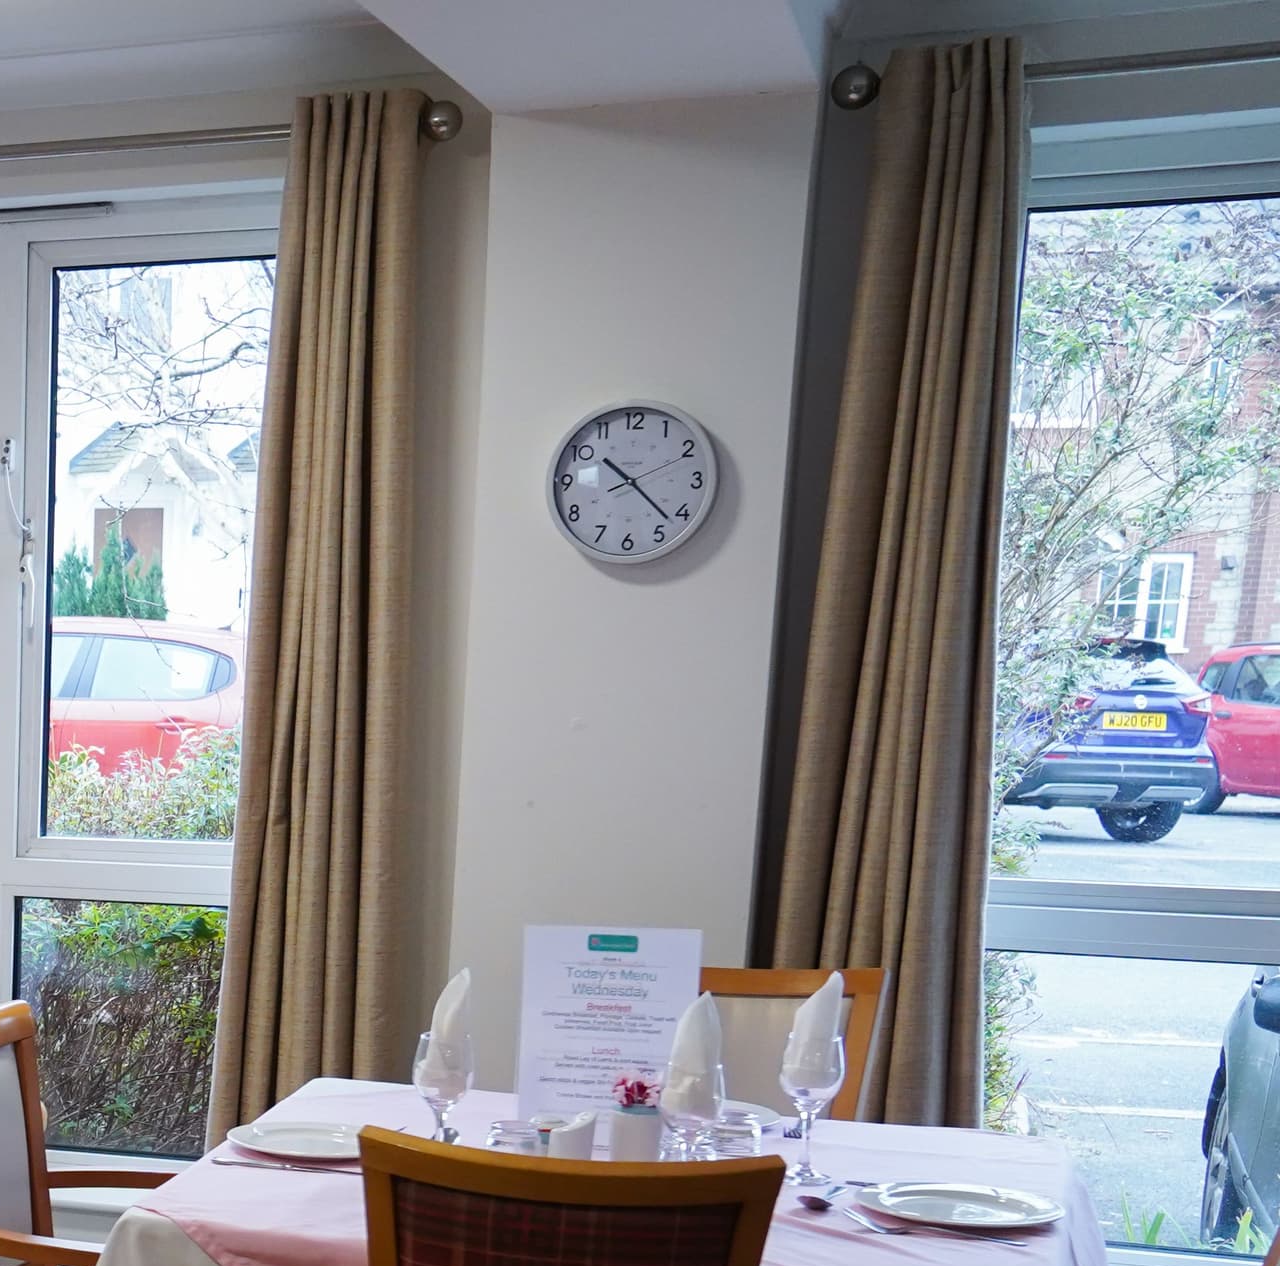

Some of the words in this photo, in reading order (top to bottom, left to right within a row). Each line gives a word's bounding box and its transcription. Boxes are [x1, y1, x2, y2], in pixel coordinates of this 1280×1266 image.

[625, 411, 645, 430] 12
[662, 420, 668, 438] 1
[596, 421, 609, 440] 11
[571, 444, 594, 462] 10
[681, 439, 695, 458] 2
[561, 473, 573, 491] 9
[690, 471, 703, 489] 3
[568, 504, 580, 522] 8
[674, 503, 690, 521] 4
[594, 525, 607, 543] 7
[621, 533, 634, 551] 6
[653, 524, 665, 543] 5
[1140, 715, 1161, 728] GFU
[564, 966, 617, 981] Today's
[620, 969, 657, 982] Menu
[571, 983, 649, 1000] Wednesday
[586, 1002, 632, 1012] Breakfast
[592, 1047, 621, 1056] Lunch
